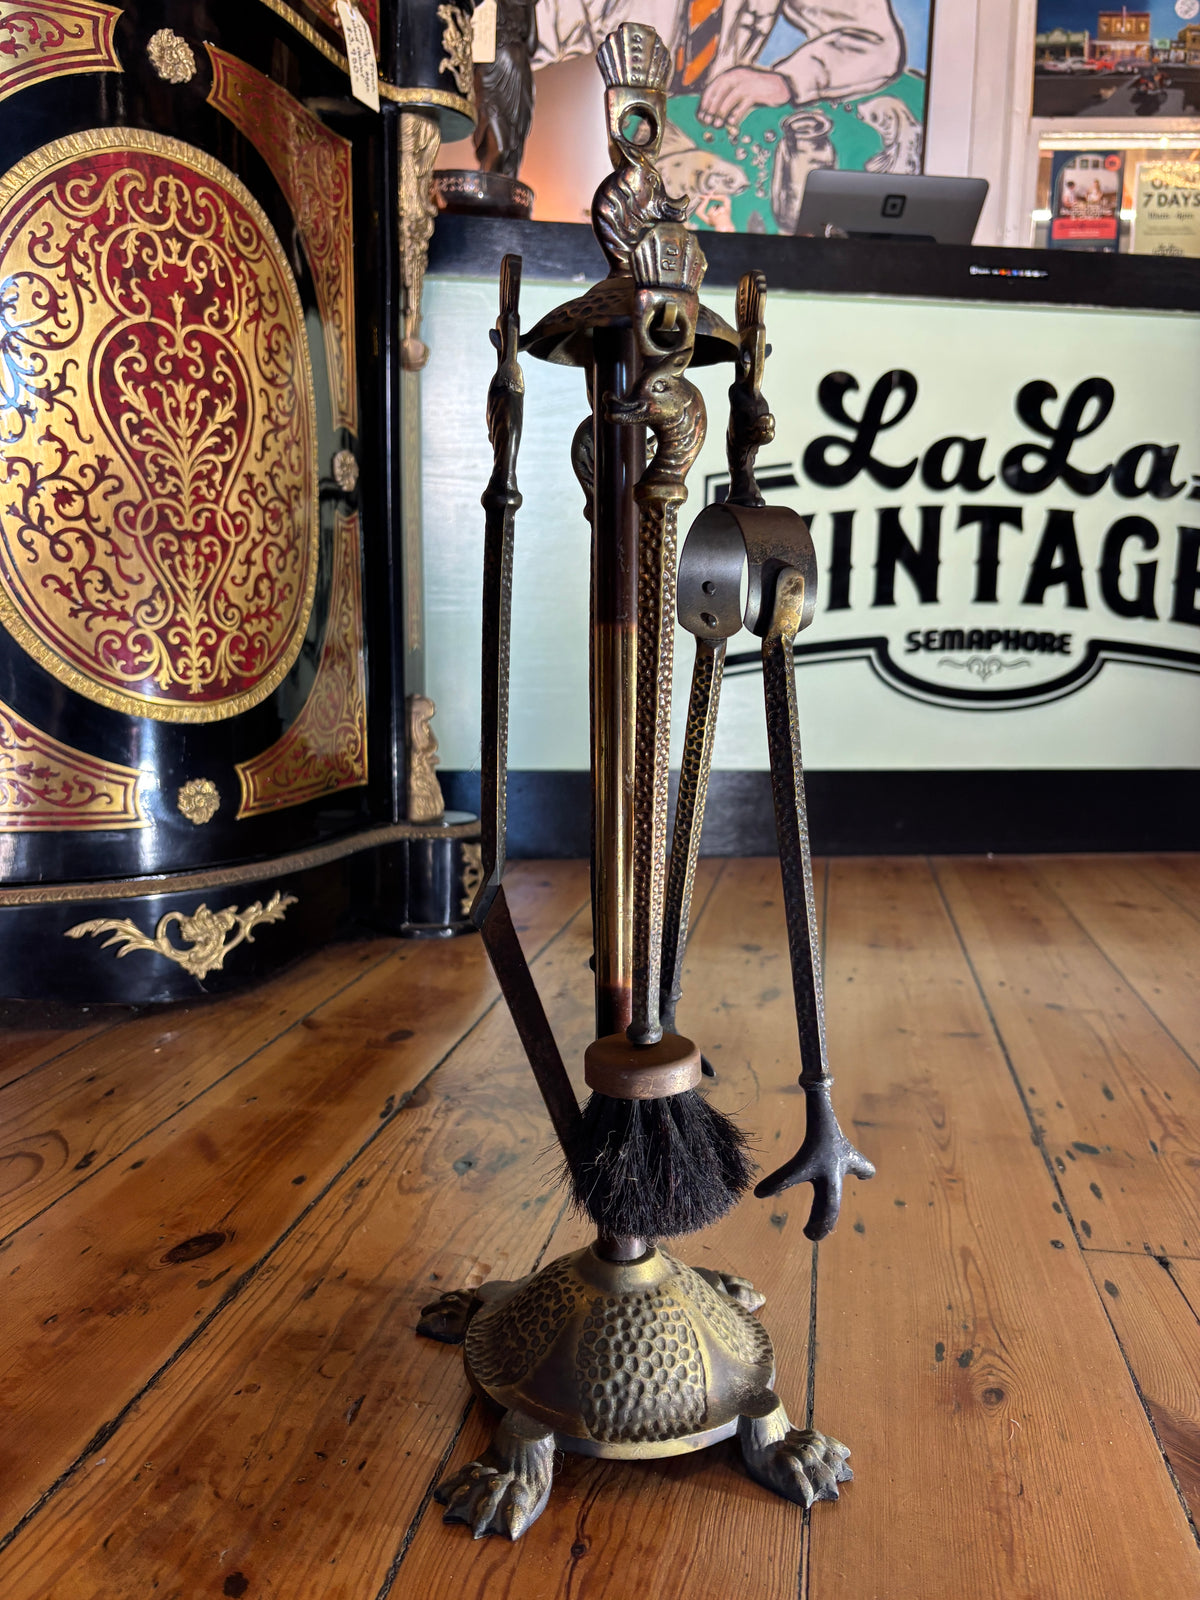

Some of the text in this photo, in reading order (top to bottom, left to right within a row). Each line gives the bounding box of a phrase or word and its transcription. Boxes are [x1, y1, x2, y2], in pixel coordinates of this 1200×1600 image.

[1143, 192, 1200, 208] 7 DAYS
[799, 504, 1200, 628] INTAGE
[905, 629, 1072, 655] SEMAPHORE
